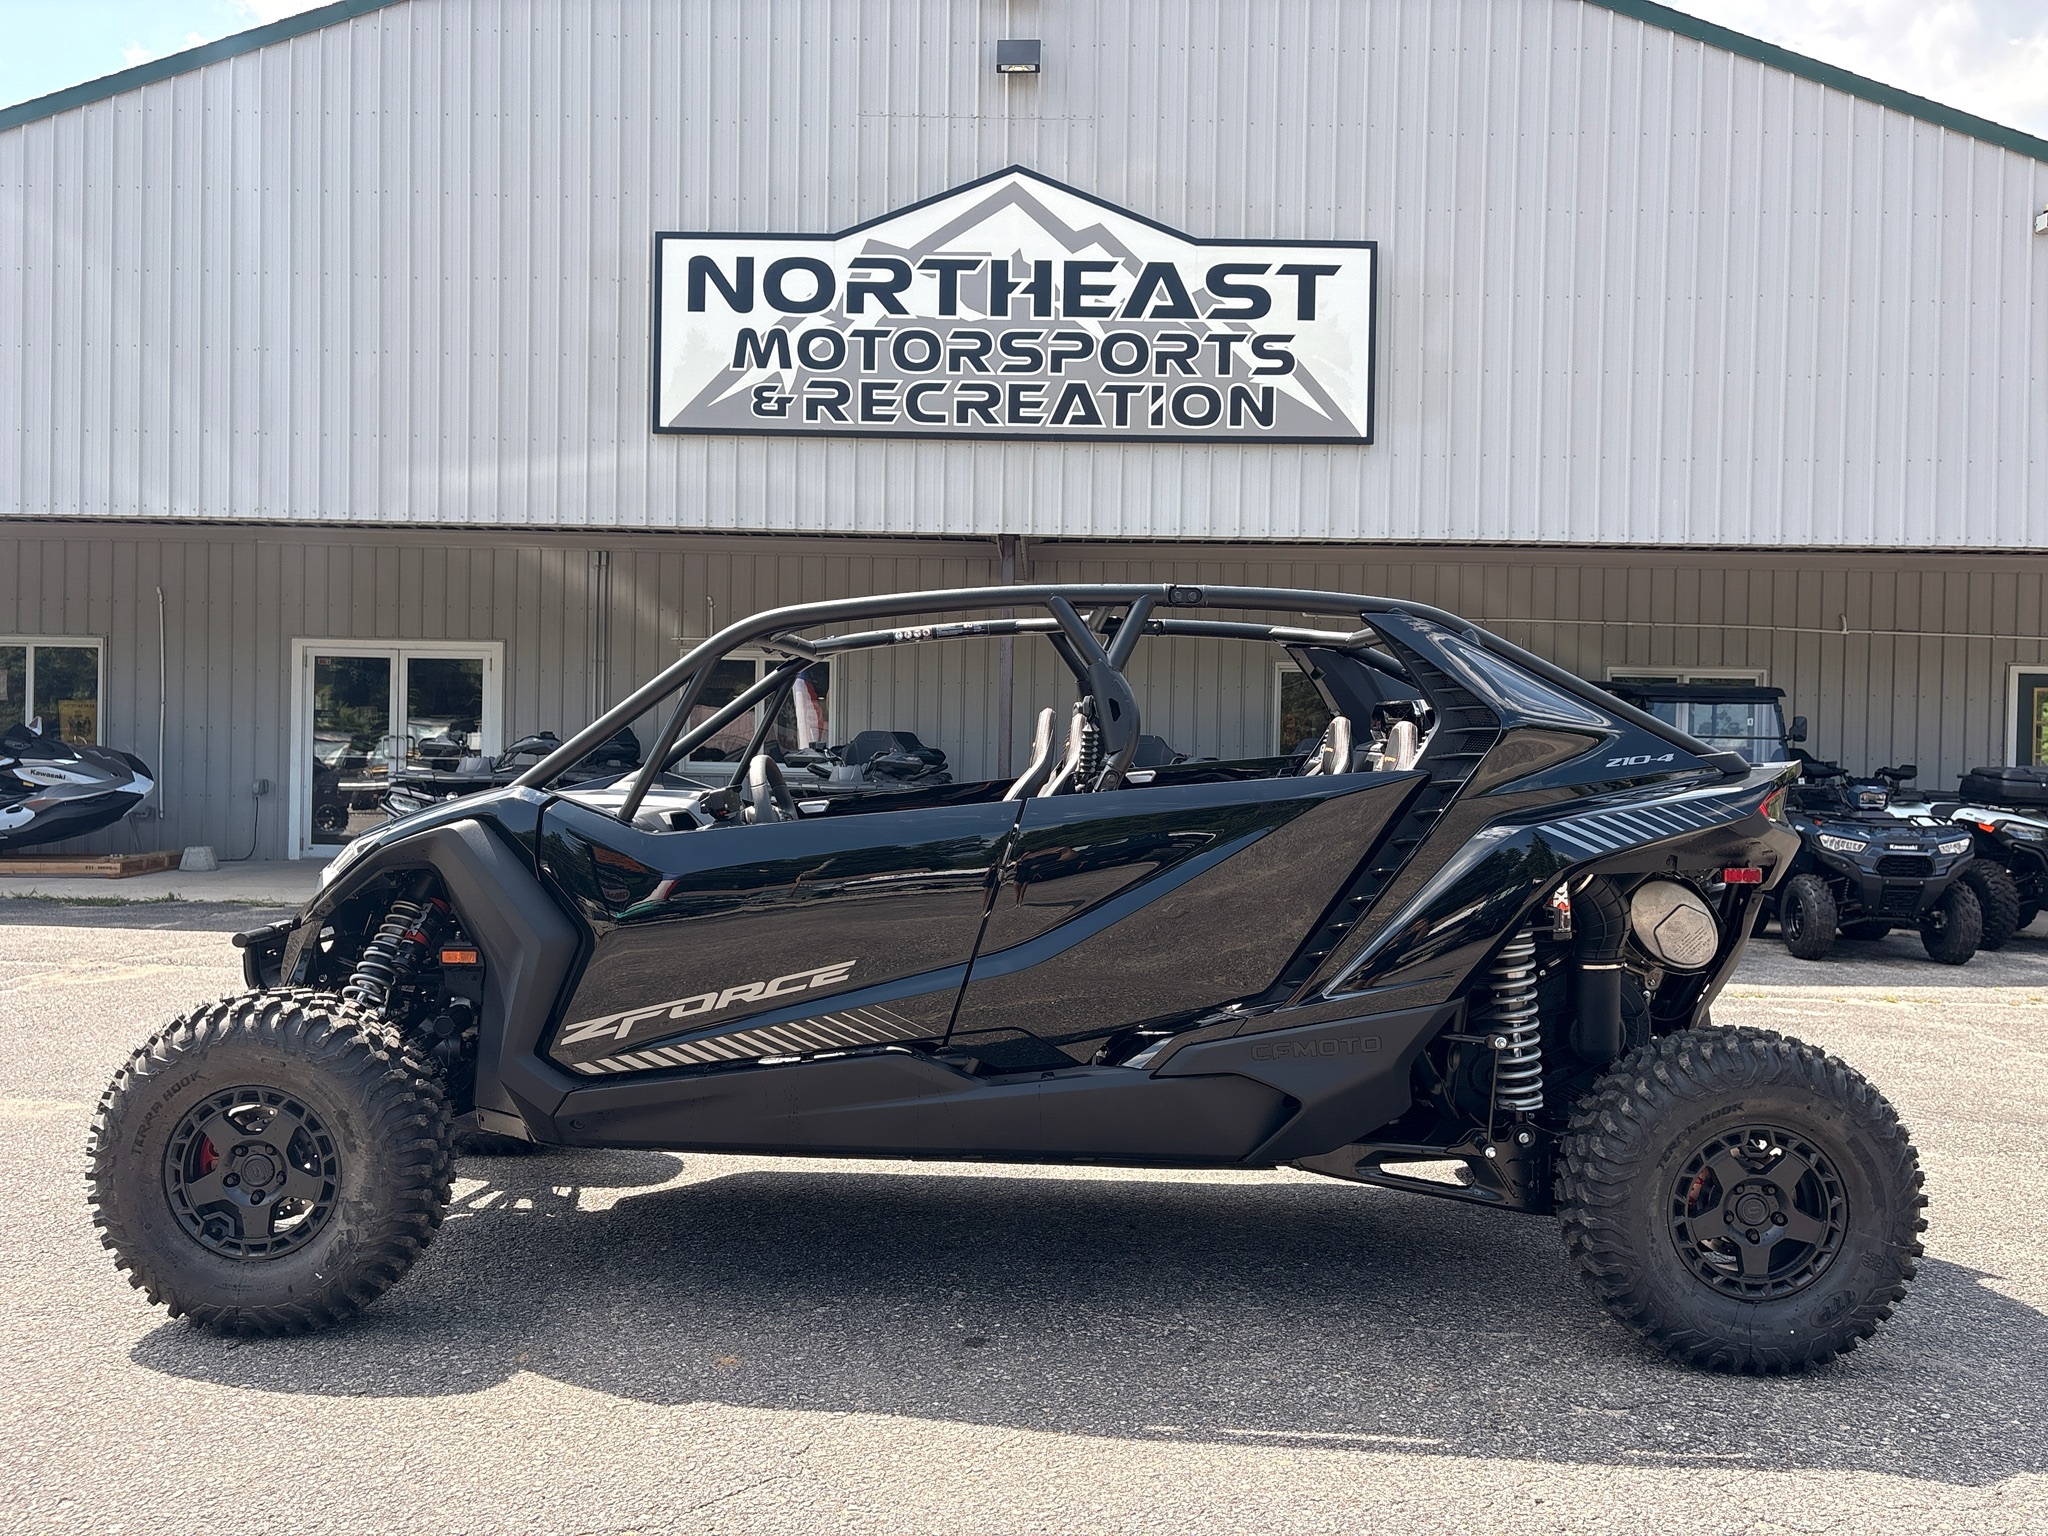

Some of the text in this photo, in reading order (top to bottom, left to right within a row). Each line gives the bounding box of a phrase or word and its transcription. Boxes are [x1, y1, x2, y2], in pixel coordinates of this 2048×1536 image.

[687, 254, 1343, 322] NORTHEAST
[732, 327, 1297, 377] MOTORSPORTS
[30, 769, 66, 780] Kawasaki
[1605, 753, 1675, 768] Z10-4
[560, 959, 857, 1046] ZFORCE
[1251, 1035, 1383, 1062] CFMOTO
[162, 1070, 207, 1102] HOOK
